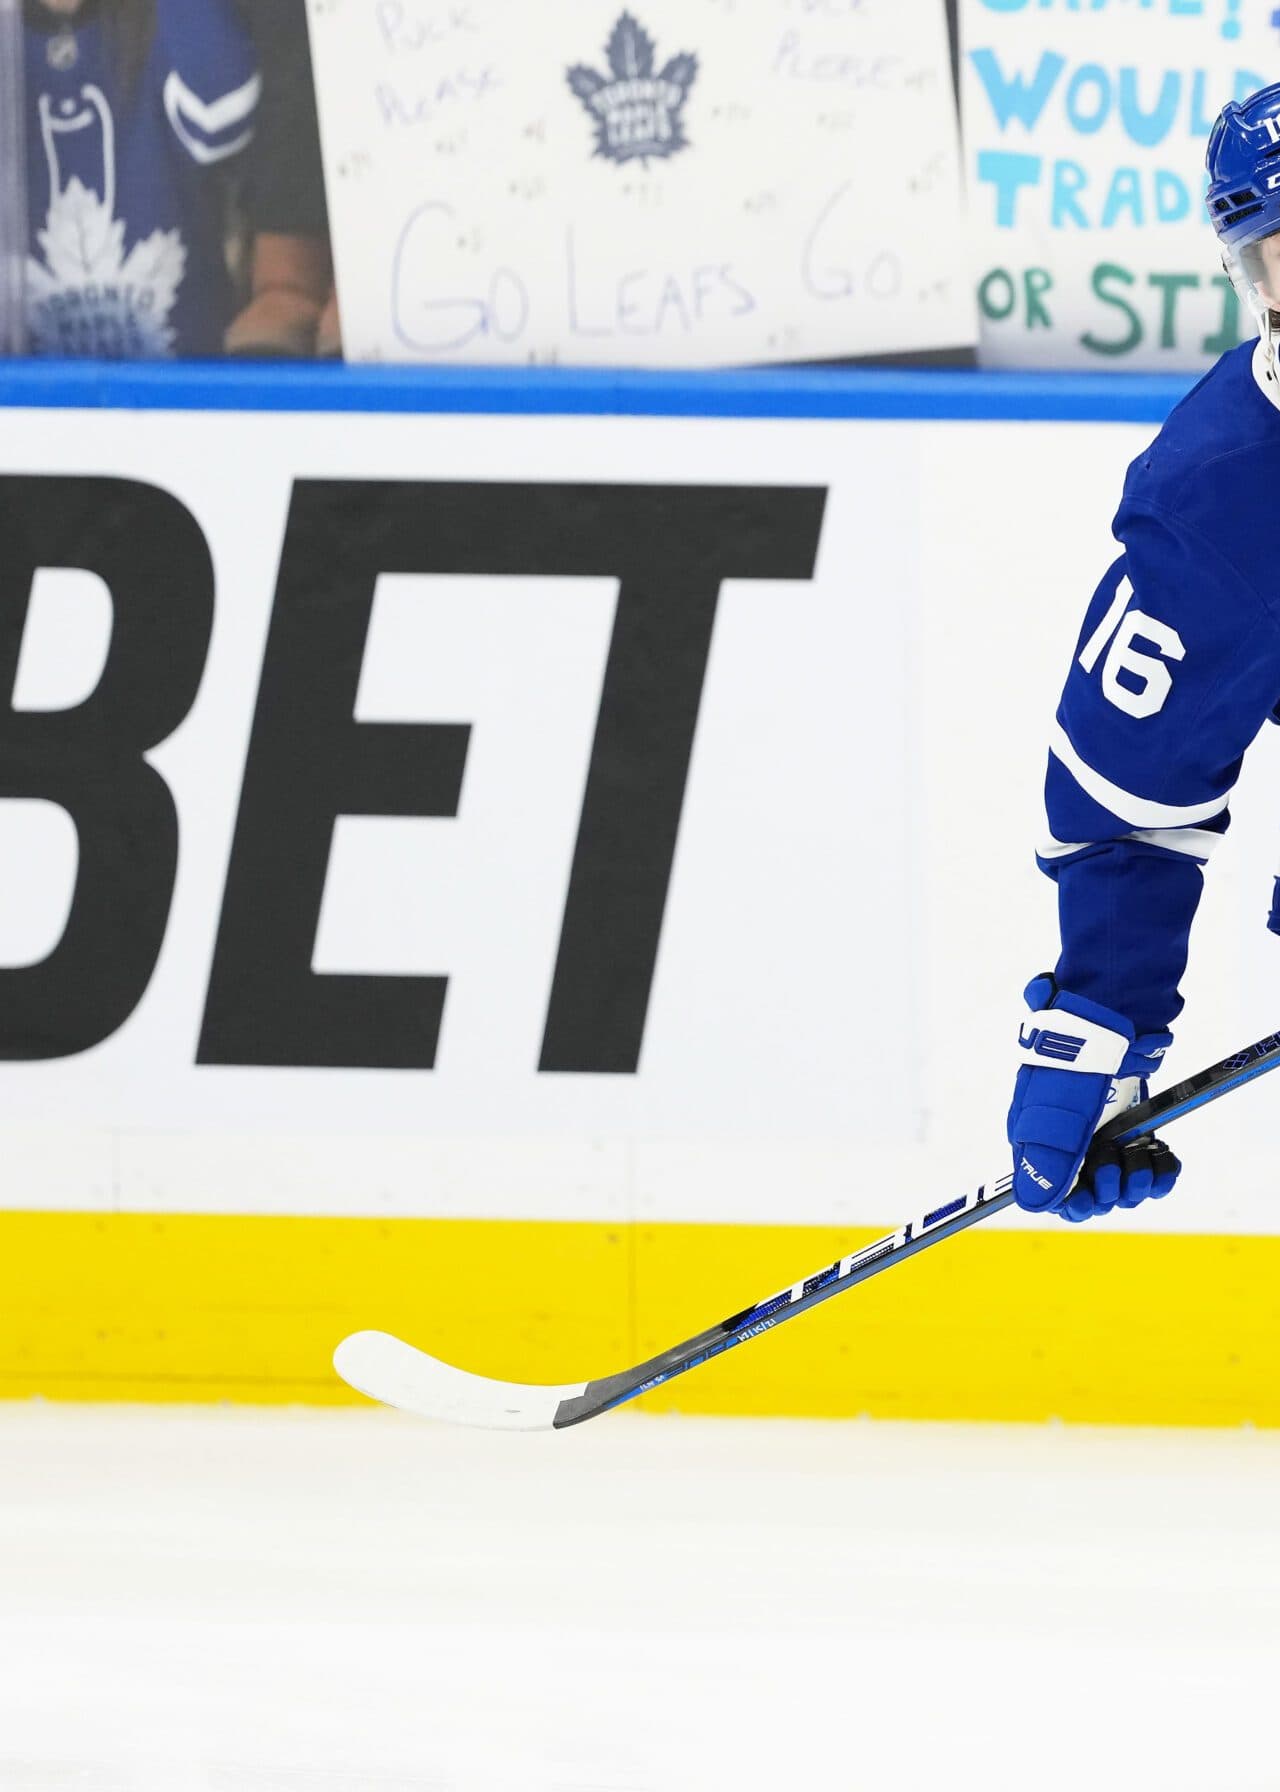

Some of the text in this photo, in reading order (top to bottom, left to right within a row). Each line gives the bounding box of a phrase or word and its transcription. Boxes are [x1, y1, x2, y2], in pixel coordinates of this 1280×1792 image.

[977, 150, 1214, 229] TRAD
[978, 265, 1053, 329] OR
[1078, 574, 1186, 719] 16
[0, 473, 830, 1074] BET
[1020, 1157, 1054, 1191] TRUE
